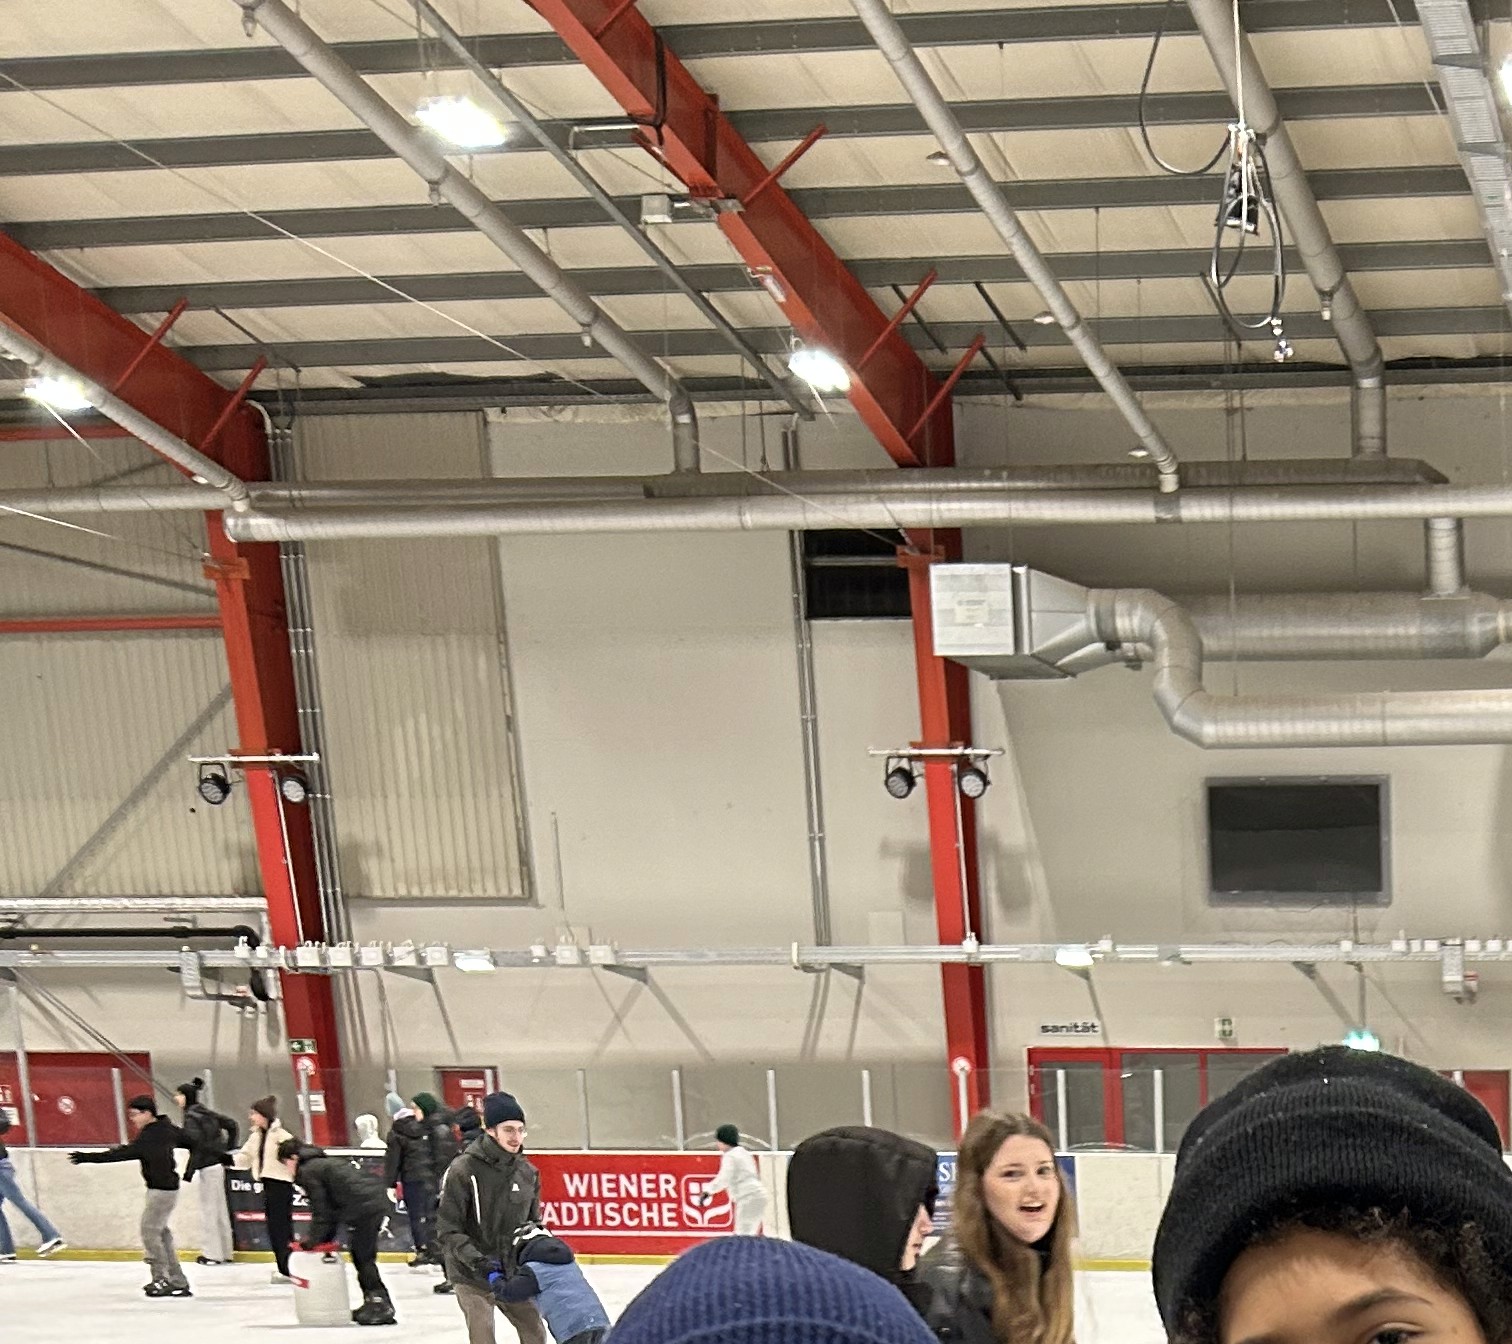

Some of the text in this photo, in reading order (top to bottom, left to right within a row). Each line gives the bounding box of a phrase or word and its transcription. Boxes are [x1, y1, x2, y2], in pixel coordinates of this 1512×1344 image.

[1041, 1021, 1099, 1034] sanität
[231, 1179, 252, 1191] Die
[562, 1172, 679, 1199] WIENER
[540, 1201, 679, 1228] ÄDTISCHE
